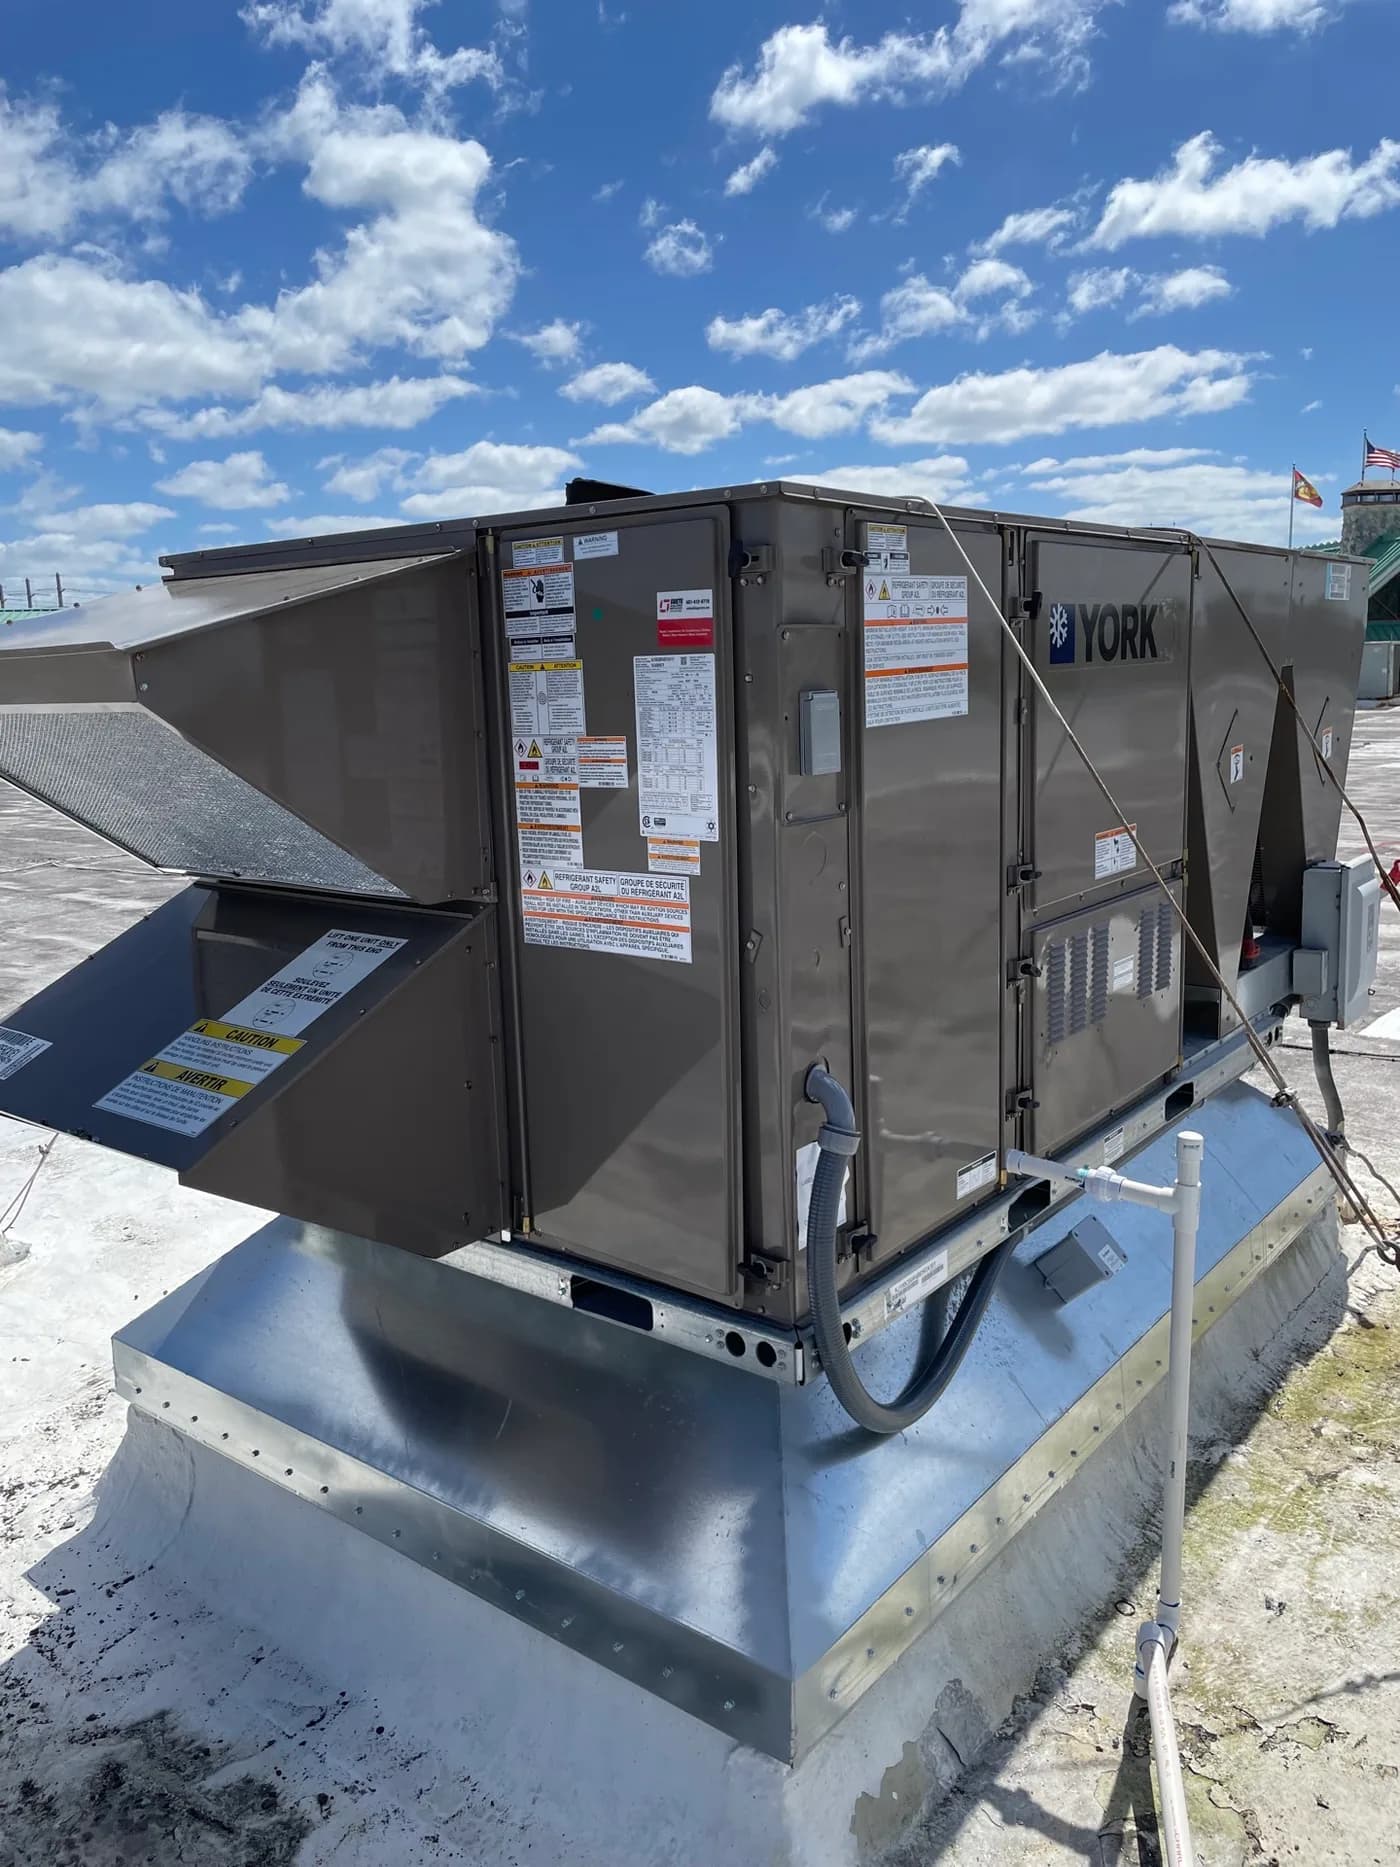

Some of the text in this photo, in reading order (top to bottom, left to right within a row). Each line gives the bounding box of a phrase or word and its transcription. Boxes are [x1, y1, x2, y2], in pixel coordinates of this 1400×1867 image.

[1078, 603, 1158, 663] YORK
[554, 873, 615, 884] REFRIGERANT SAFETY
[619, 878, 644, 887] GROUPE
[569, 882, 600, 892] GROUP A2L
[621, 886, 629, 895] DU
[672, 890, 684, 899] A2L
[326, 941, 383, 954] FROM THIS END
[377, 939, 401, 948] ONLY
[267, 980, 309, 992] SEULEMENT
[308, 986, 320, 994] UN
[292, 977, 331, 987] SOULEVEZ
[271, 988, 294, 998] CETTE
[225, 1029, 280, 1048] CAUTION
[211, 1040, 254, 1055] INSTRUCTIONS
[132, 1075, 173, 1091] INSTRUCTIONS
[171, 1085, 183, 1093] DE
[175, 1070, 229, 1091] AVERTIR
